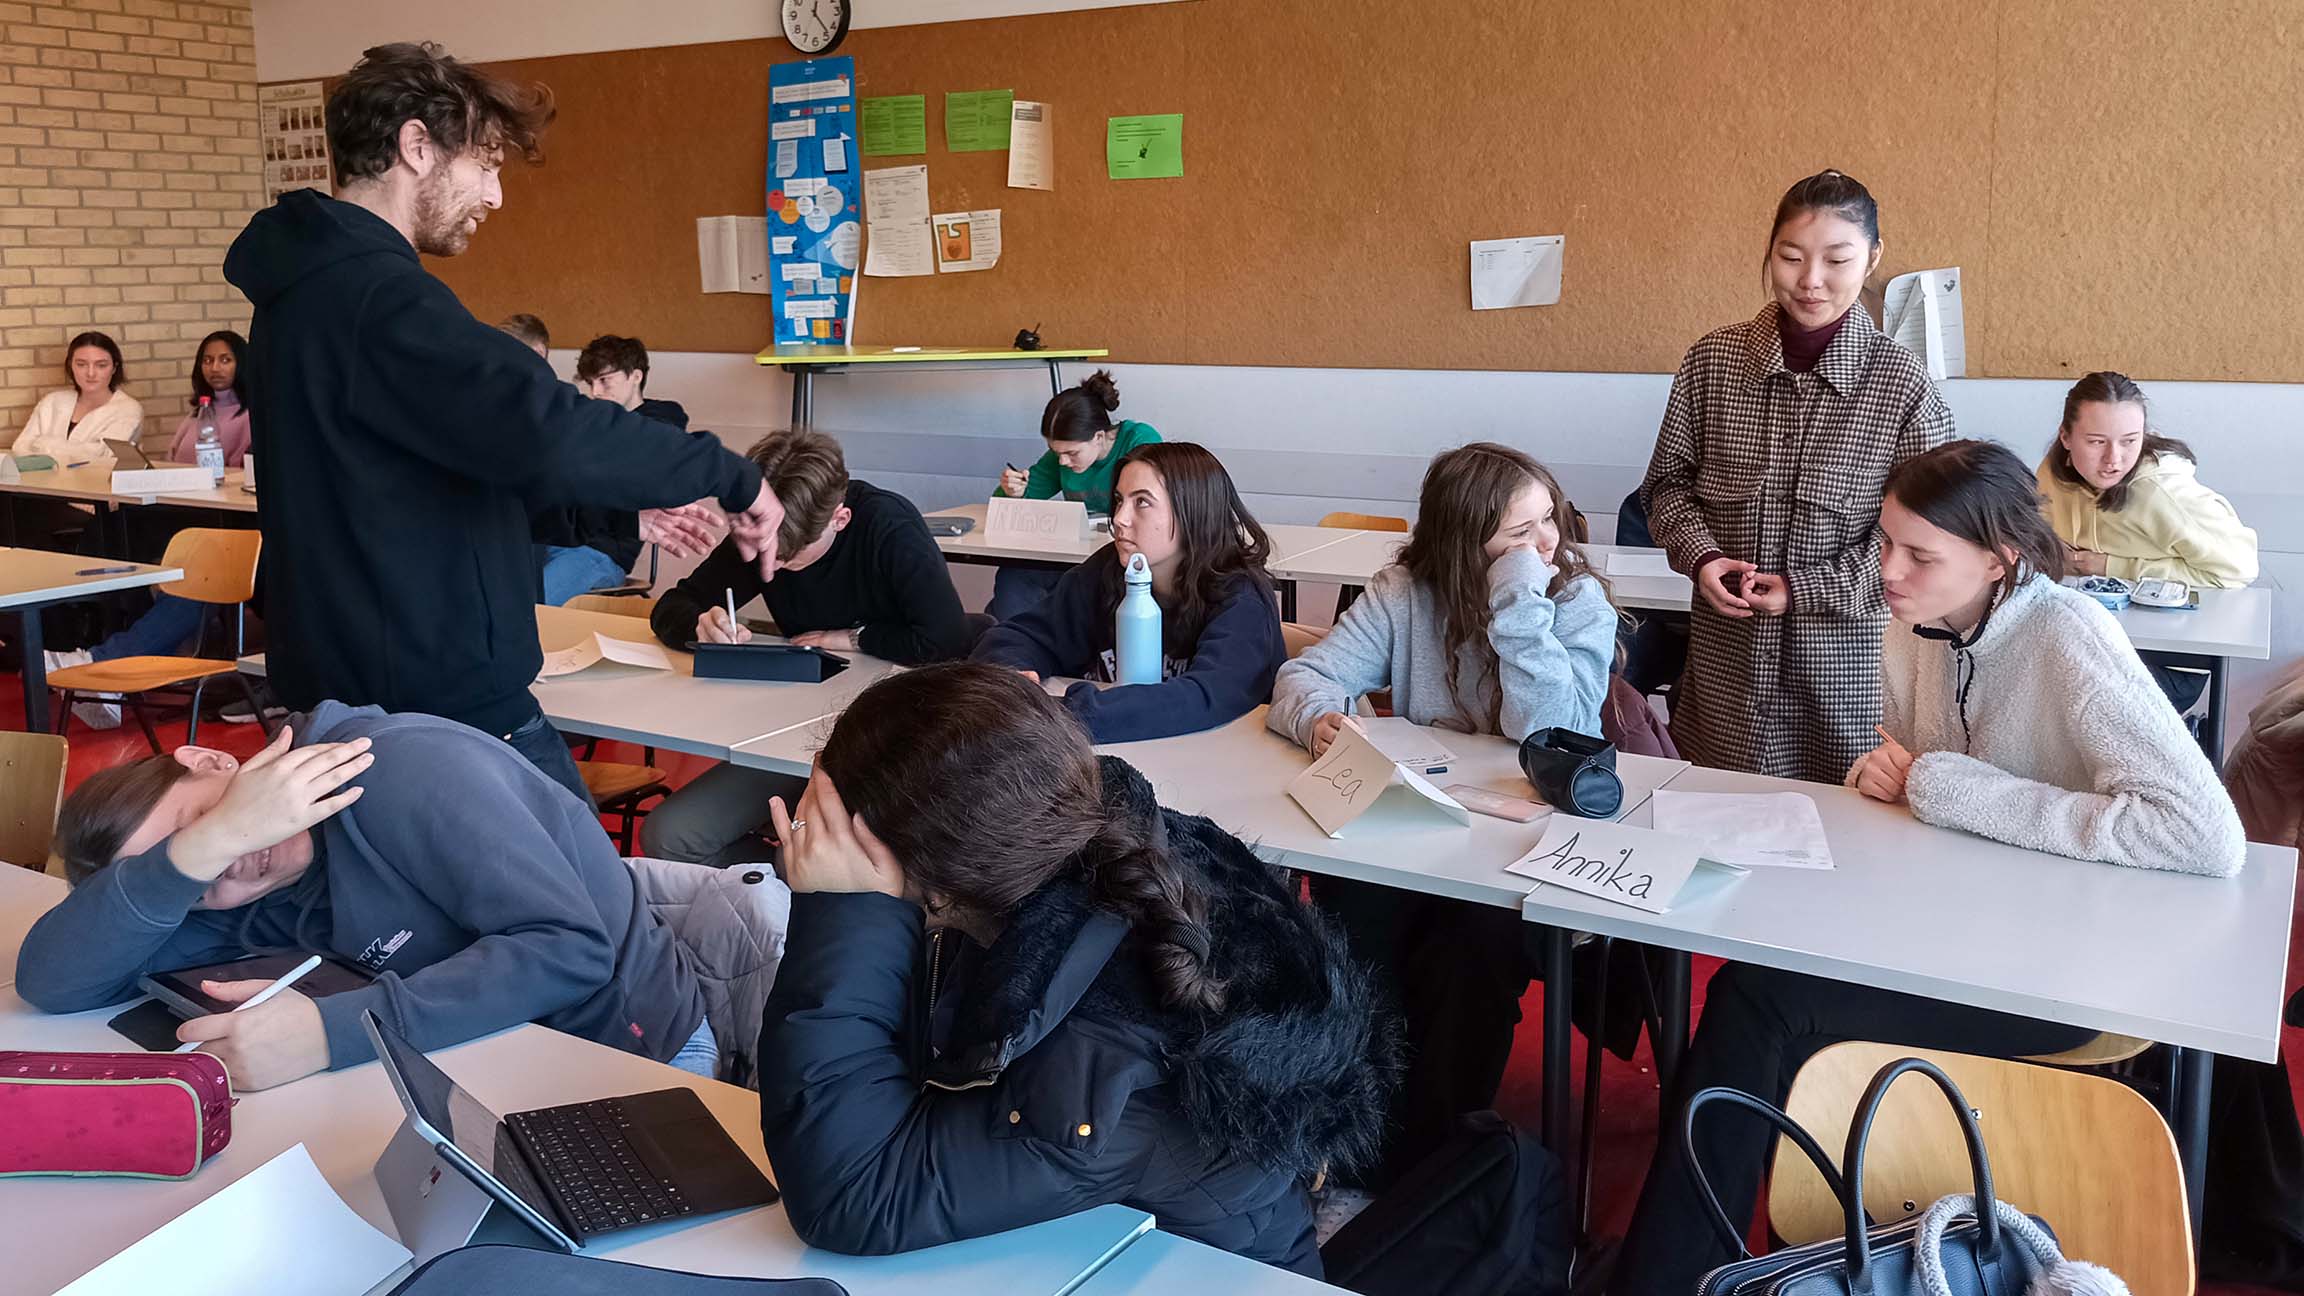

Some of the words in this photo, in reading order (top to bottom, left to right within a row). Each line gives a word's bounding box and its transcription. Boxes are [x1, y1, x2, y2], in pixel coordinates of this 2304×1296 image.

[790, 10, 797, 20] 9
[794, 25, 801, 34] 8
[802, 33, 808, 43] 7
[823, 32, 830, 41] 5
[811, 37, 819, 47] 6
[993, 503, 1058, 533] Nina
[1311, 744, 1363, 805] Lea
[1528, 831, 1653, 899] Annika
